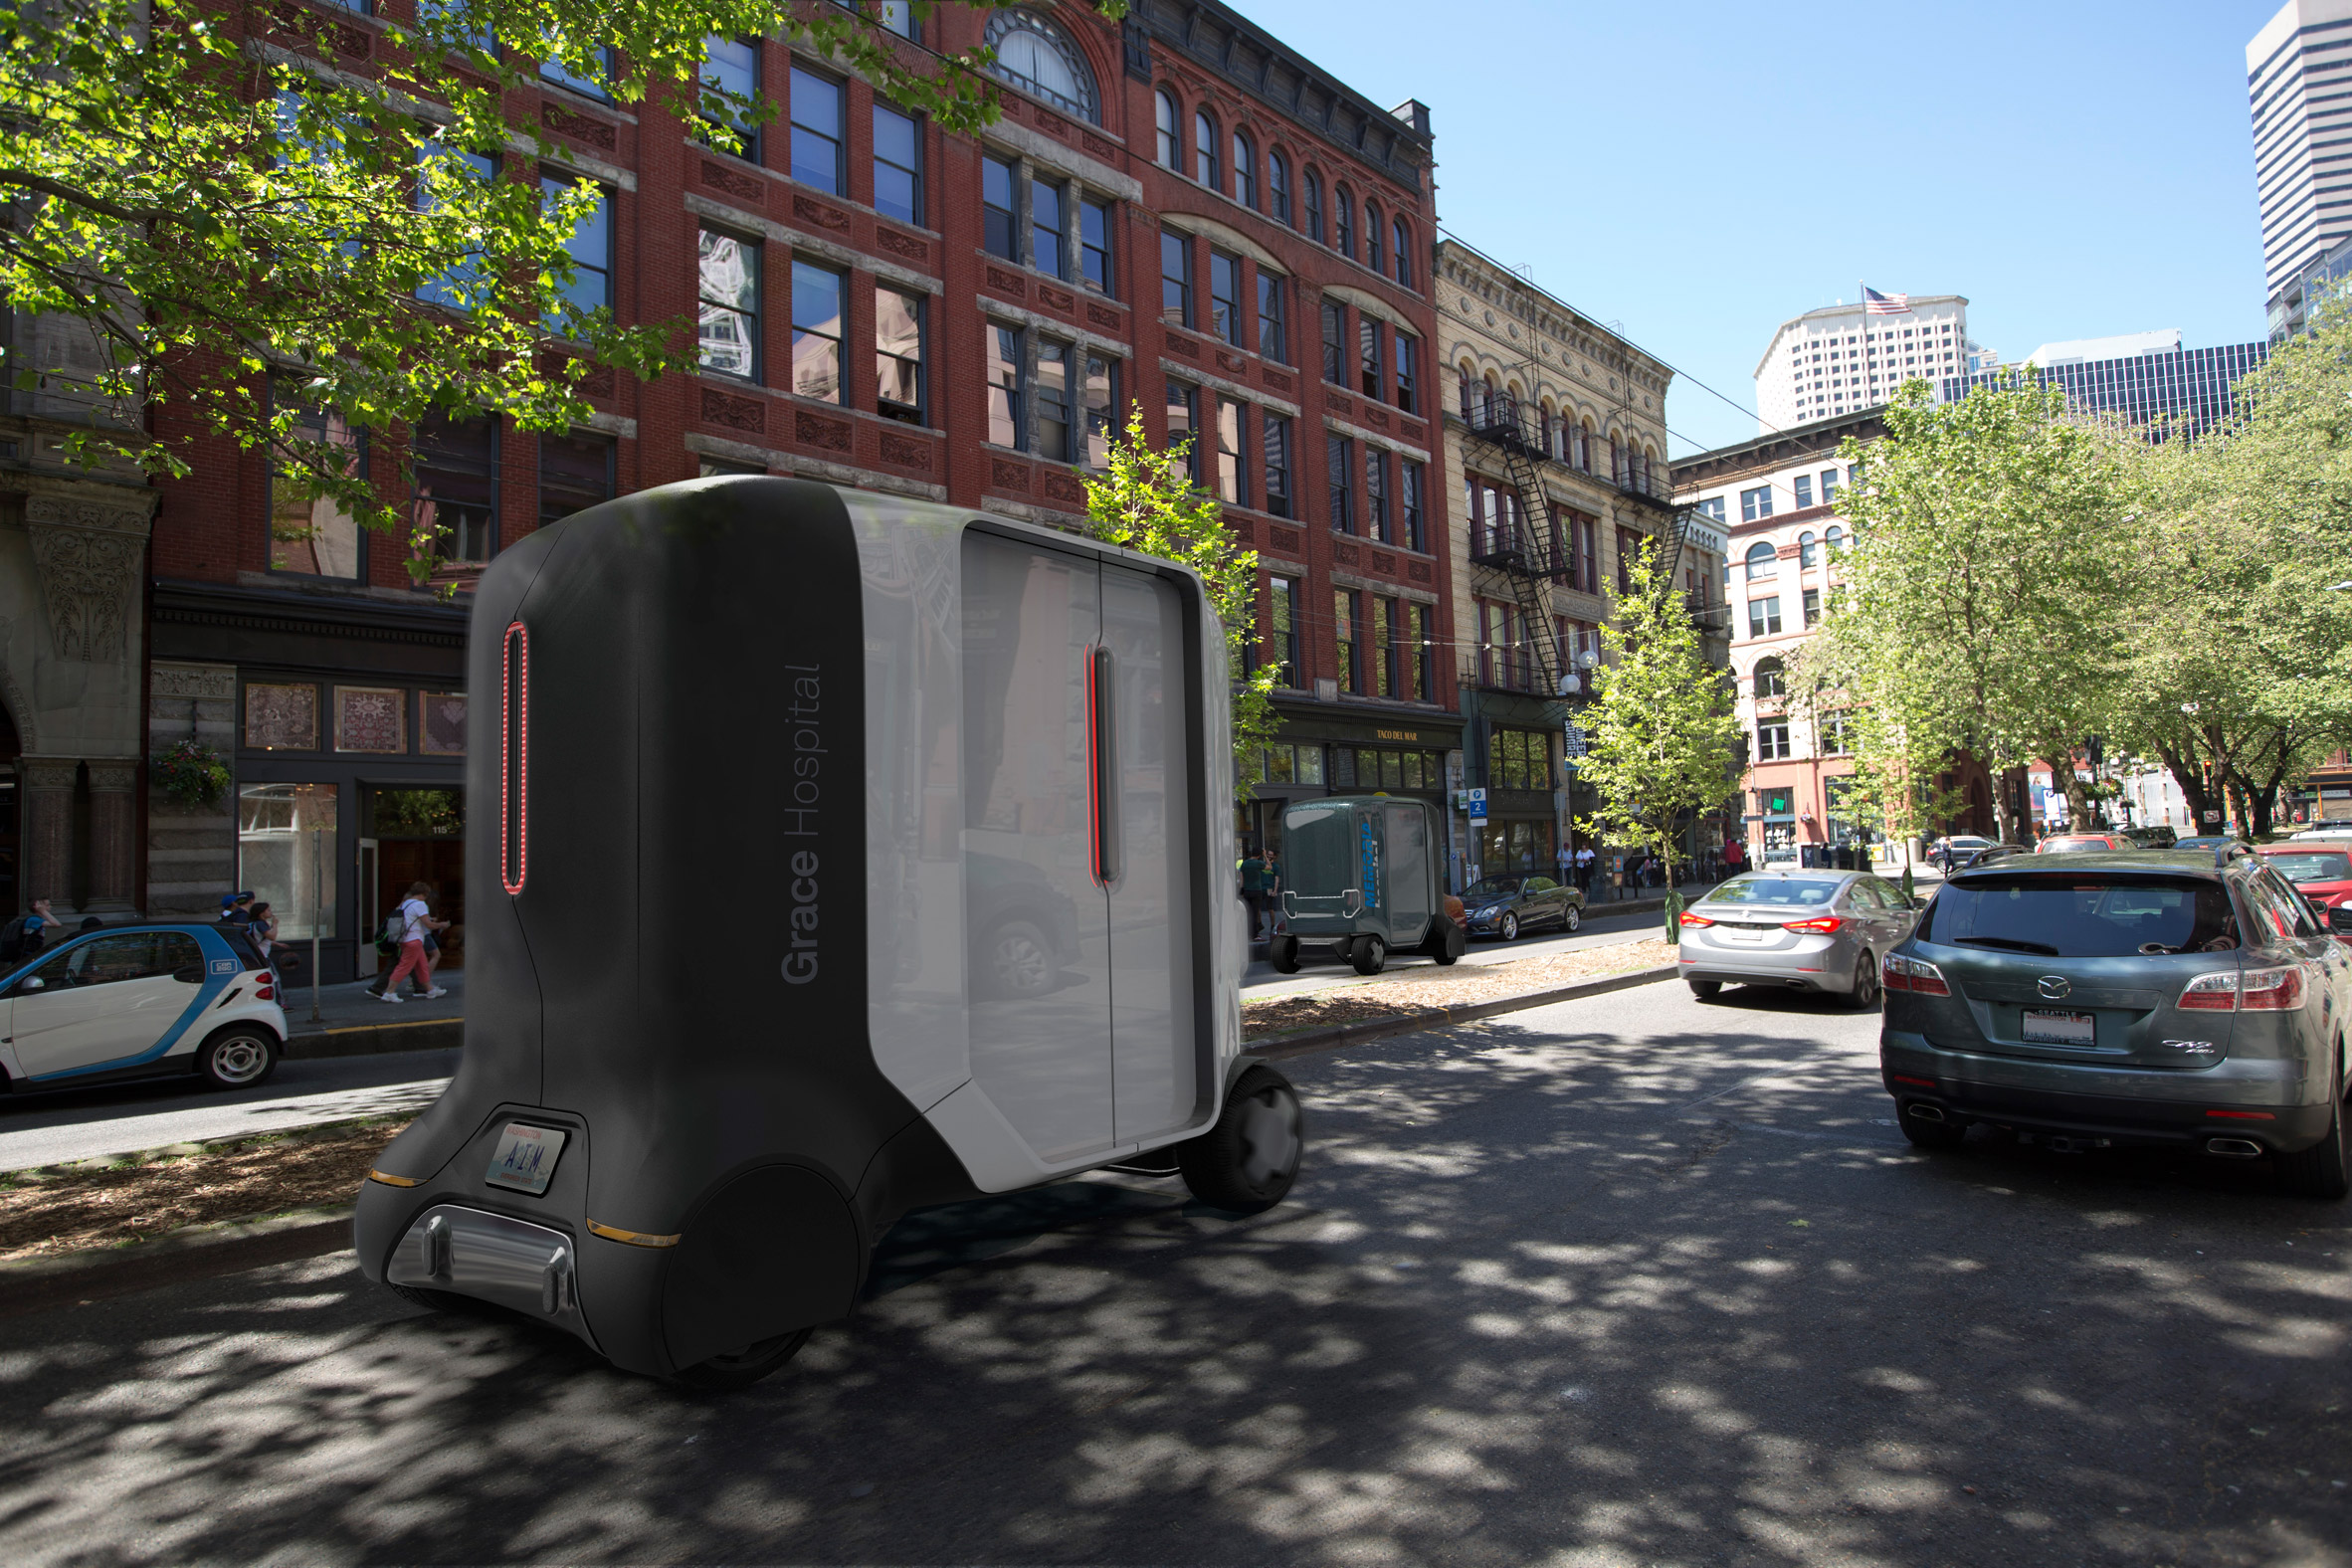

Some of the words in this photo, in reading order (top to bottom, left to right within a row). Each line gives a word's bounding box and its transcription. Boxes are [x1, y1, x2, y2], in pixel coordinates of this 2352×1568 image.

[1377, 729, 1392, 739] TACO
[1393, 730, 1403, 740] DEL
[1404, 732, 1418, 741] MAR
[1565, 719, 1576, 758] SQUARE
[784, 664, 828, 836] Hospital
[1474, 802, 1480, 811] 2
[781, 851, 819, 985] Grace
[2038, 1009, 2077, 1018] SEATTLE
[2023, 1035, 2065, 1044] UNIVERSITY
[506, 1125, 542, 1140] WASHINGTON
[504, 1141, 545, 1173] AIM
